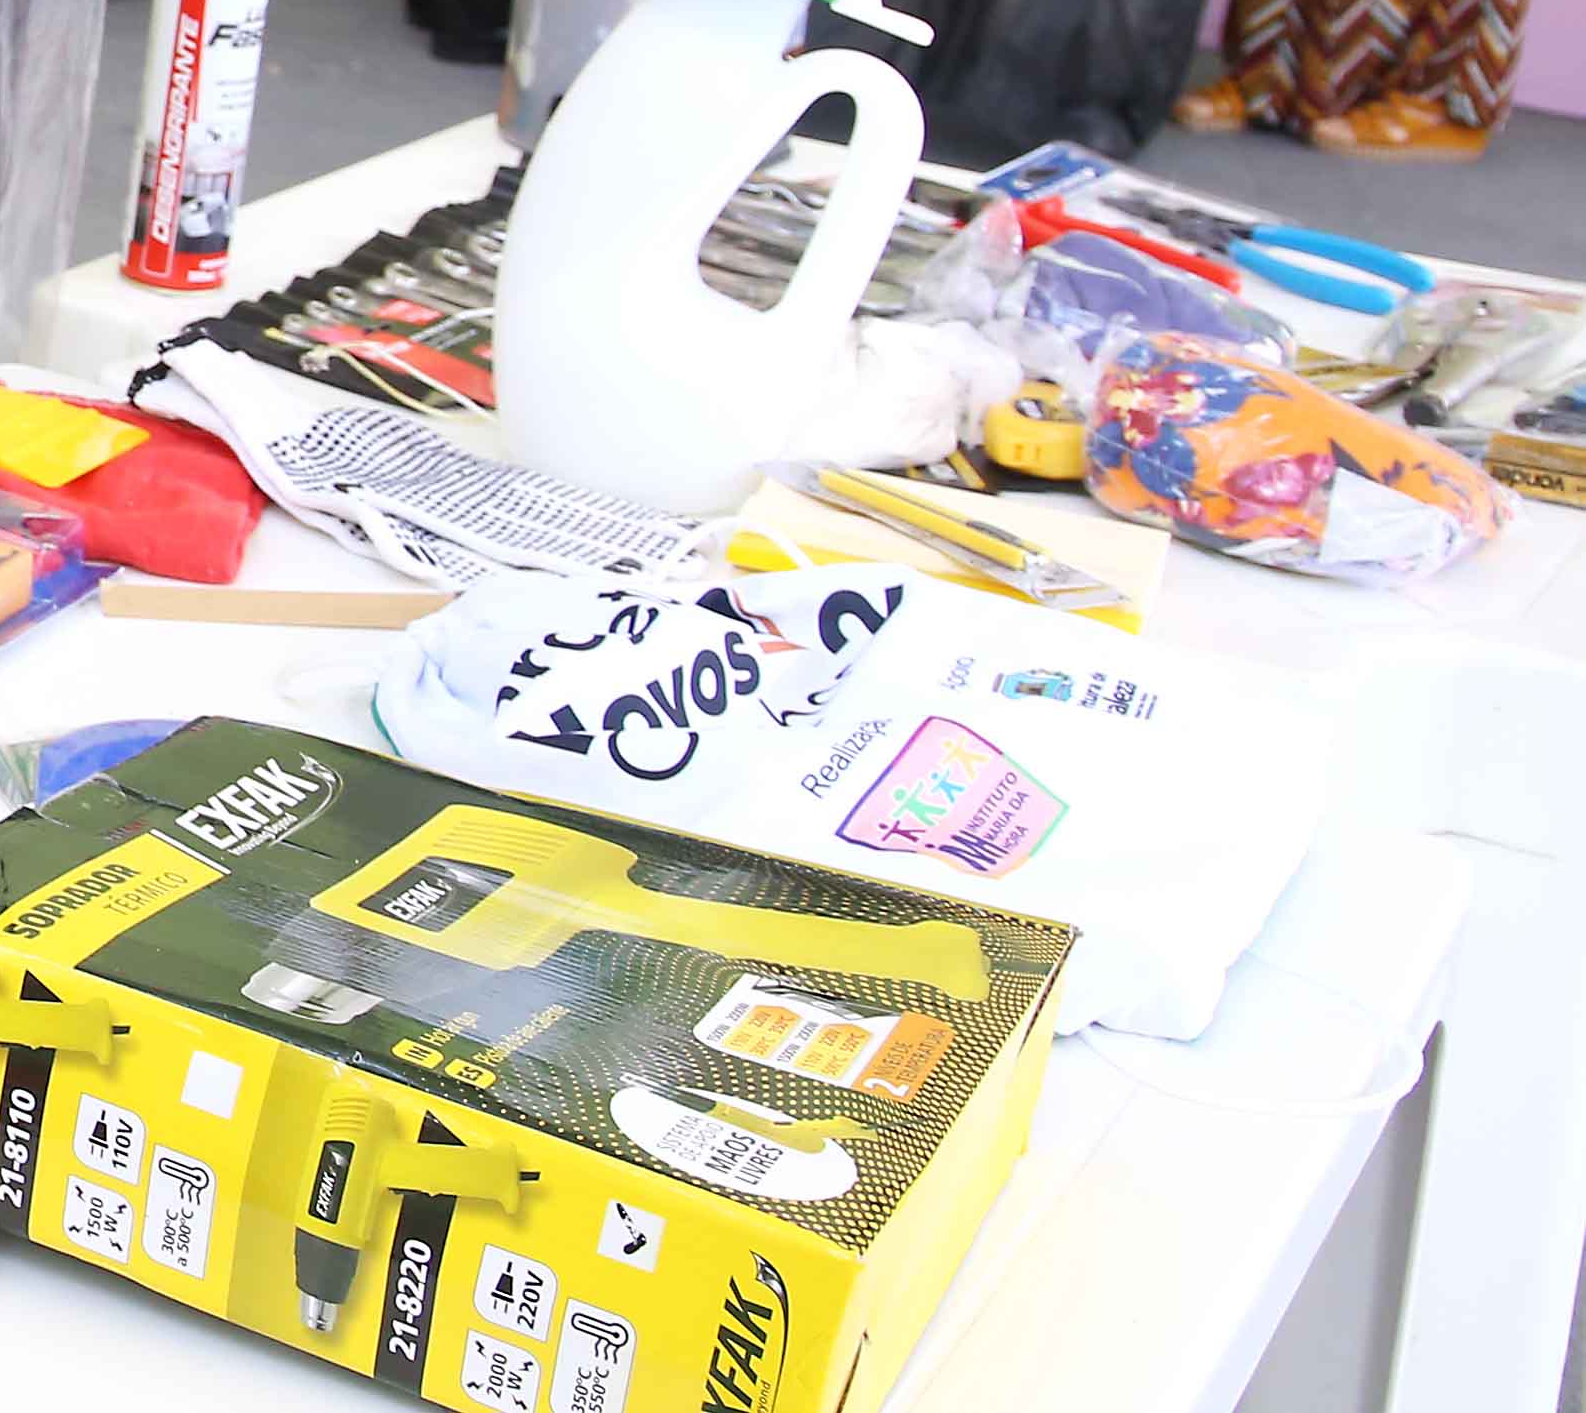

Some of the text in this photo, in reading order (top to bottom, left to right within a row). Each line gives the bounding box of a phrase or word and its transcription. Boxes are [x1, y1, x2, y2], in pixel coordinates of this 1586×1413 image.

[174, 757, 320, 850] EXFAK
[967, 771, 1018, 832] INSTITUTO
[1009, 790, 1030, 811] DA
[3, 863, 141, 939] SOPRADOR
[103, 871, 188, 916] TÉRMICO
[384, 880, 446, 921] EXFAK
[455, 1065, 483, 1081] ES
[863, 1077, 909, 1097] 2
[111, 1118, 136, 1170] 110V
[704, 1132, 756, 1174] MÃOS
[735, 1144, 784, 1185] LIVRES
[315, 1171, 337, 1218] EXFAK
[85, 1196, 105, 1239] 1500
[102, 1214, 119, 1234] W
[388, 1238, 434, 1363] 21-8220
[517, 1270, 545, 1331] 220V
[485, 1351, 509, 1399] 2000
[507, 1372, 523, 1391] W
